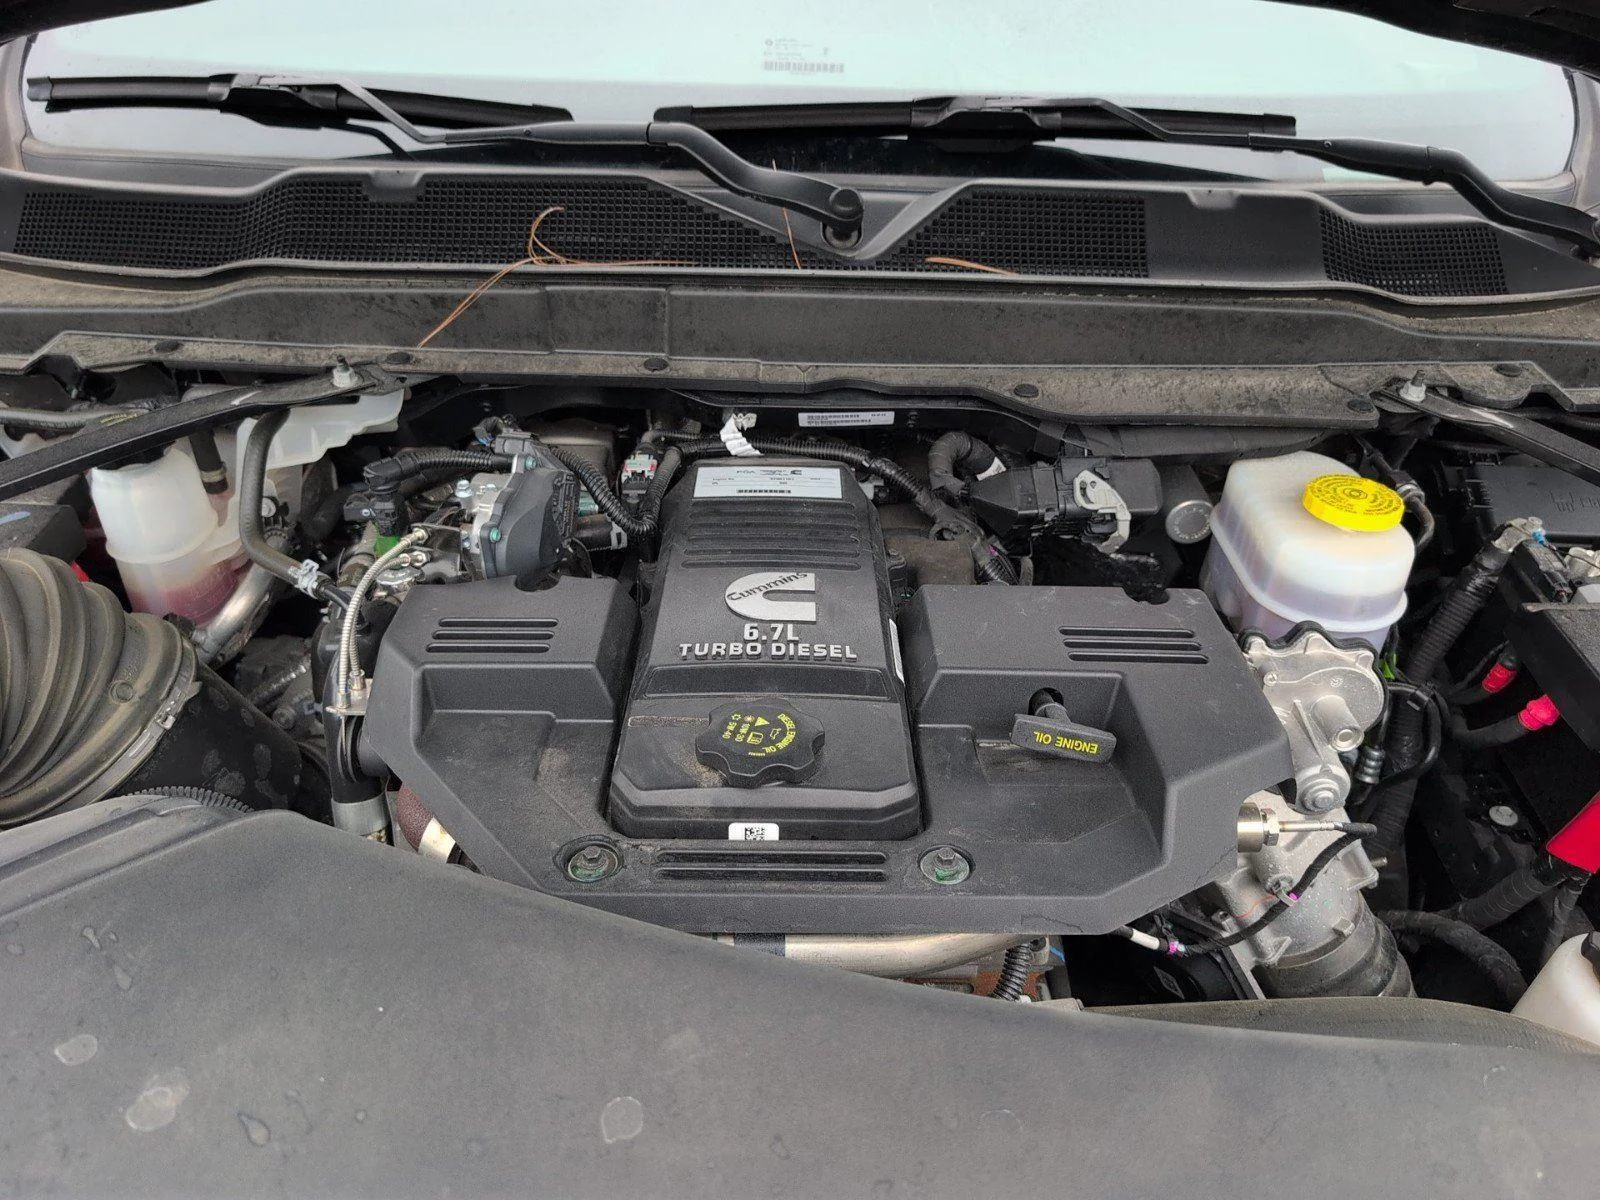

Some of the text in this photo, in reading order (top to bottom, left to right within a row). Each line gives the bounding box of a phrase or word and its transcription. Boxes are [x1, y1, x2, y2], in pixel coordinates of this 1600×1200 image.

[726, 572, 808, 601] Cummins
[743, 623, 800, 642] 6.7L
[679, 642, 858, 662] TURBO DIESEL
[762, 745, 777, 753] OIL
[1033, 731, 1099, 754] ENGINE OIL
